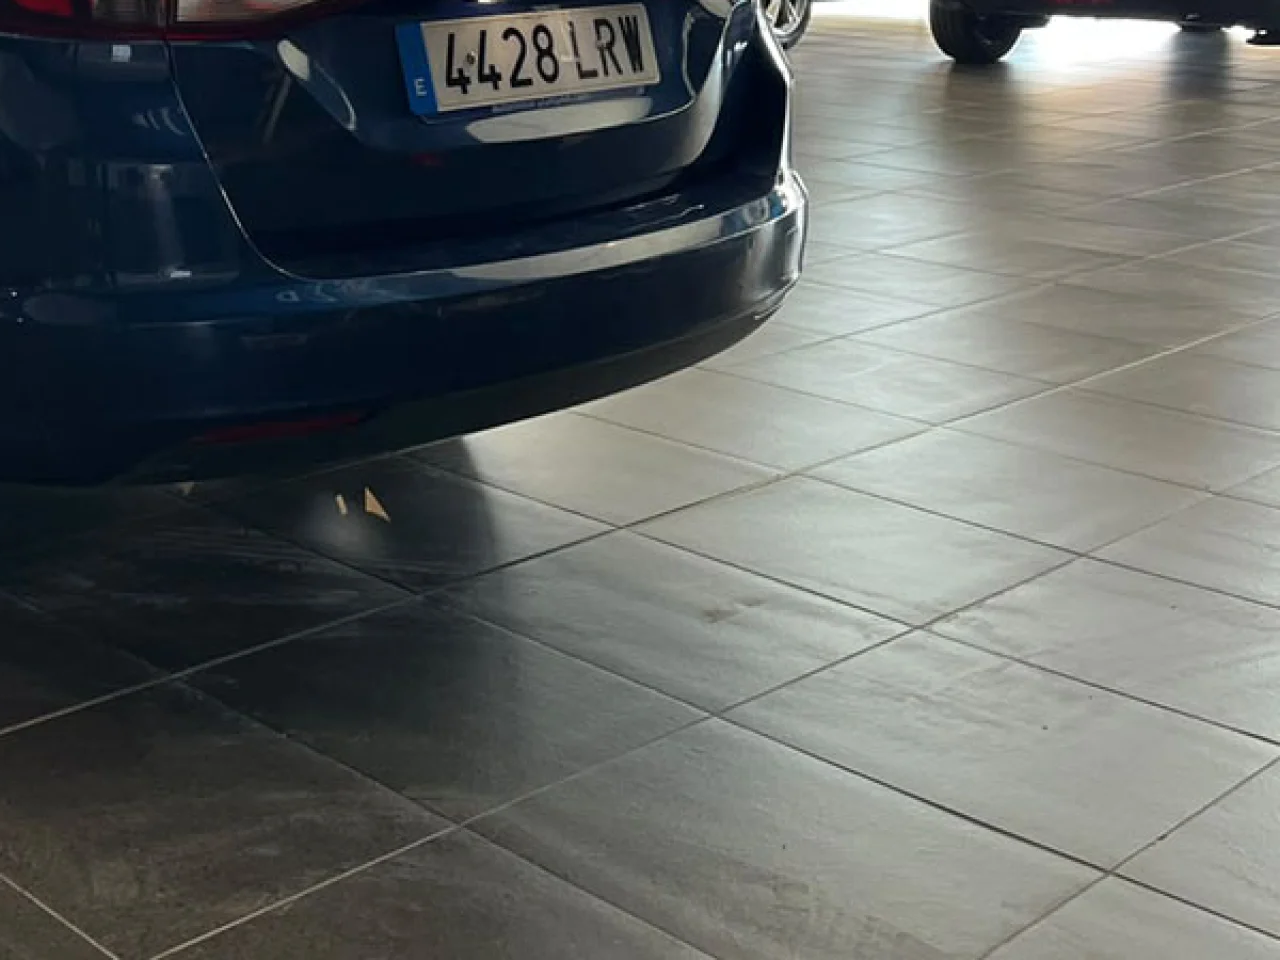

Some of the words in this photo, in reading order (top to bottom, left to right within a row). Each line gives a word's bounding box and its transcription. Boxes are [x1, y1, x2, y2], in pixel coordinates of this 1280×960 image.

[413, 77, 428, 97] E
[444, 22, 560, 96] 4428
[567, 14, 645, 80] LRW
